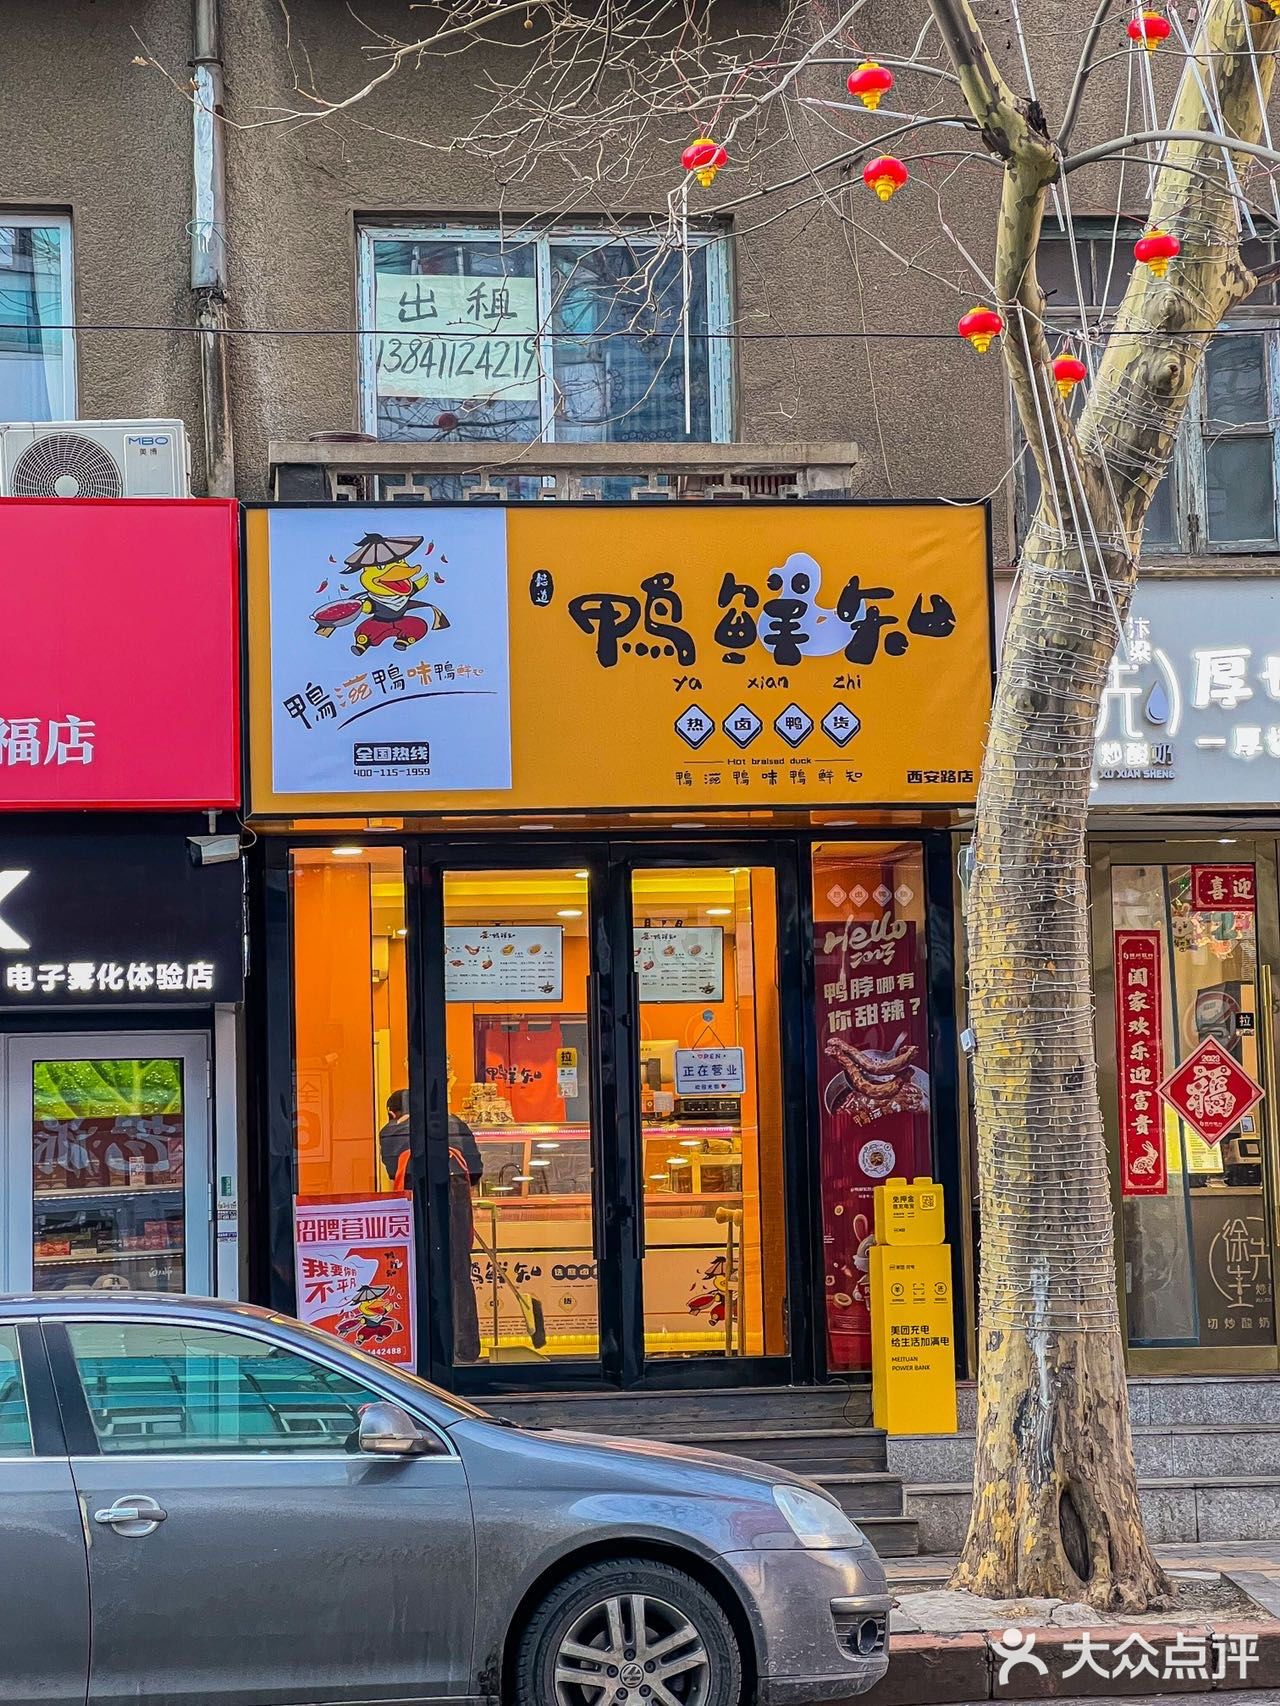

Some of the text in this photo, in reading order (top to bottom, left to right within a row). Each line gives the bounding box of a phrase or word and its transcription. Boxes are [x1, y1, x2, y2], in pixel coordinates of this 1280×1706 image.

[399, 282, 518, 322] 出租
[377, 338, 536, 380] 13841124219
[128, 437, 168, 445] MBO
[672, 676, 862, 691] ya xian zhi
[1193, 648, 1280, 708] 厚
[355, 745, 428, 763] 全国热线
[790, 757, 812, 765] duck
[353, 767, 431, 777] 400-115-1959
[907, 769, 974, 784] 西安路店
[1144, 769, 1175, 779] SHENG
[1208, 876, 1254, 900] 喜迎
[6, 962, 214, 991] 电子雾化体验店
[823, 972, 915, 1005] 鸭脖哪有
[561, 1051, 572, 1062] 拉
[683, 1064, 737, 1077] 正在营业
[1186, 1065, 1236, 1118] 福
[297, 1216, 409, 1242] 招聘营业员
[891, 1325, 929, 1335] 美团充电
[891, 1337, 950, 1347] 给生活加满电
